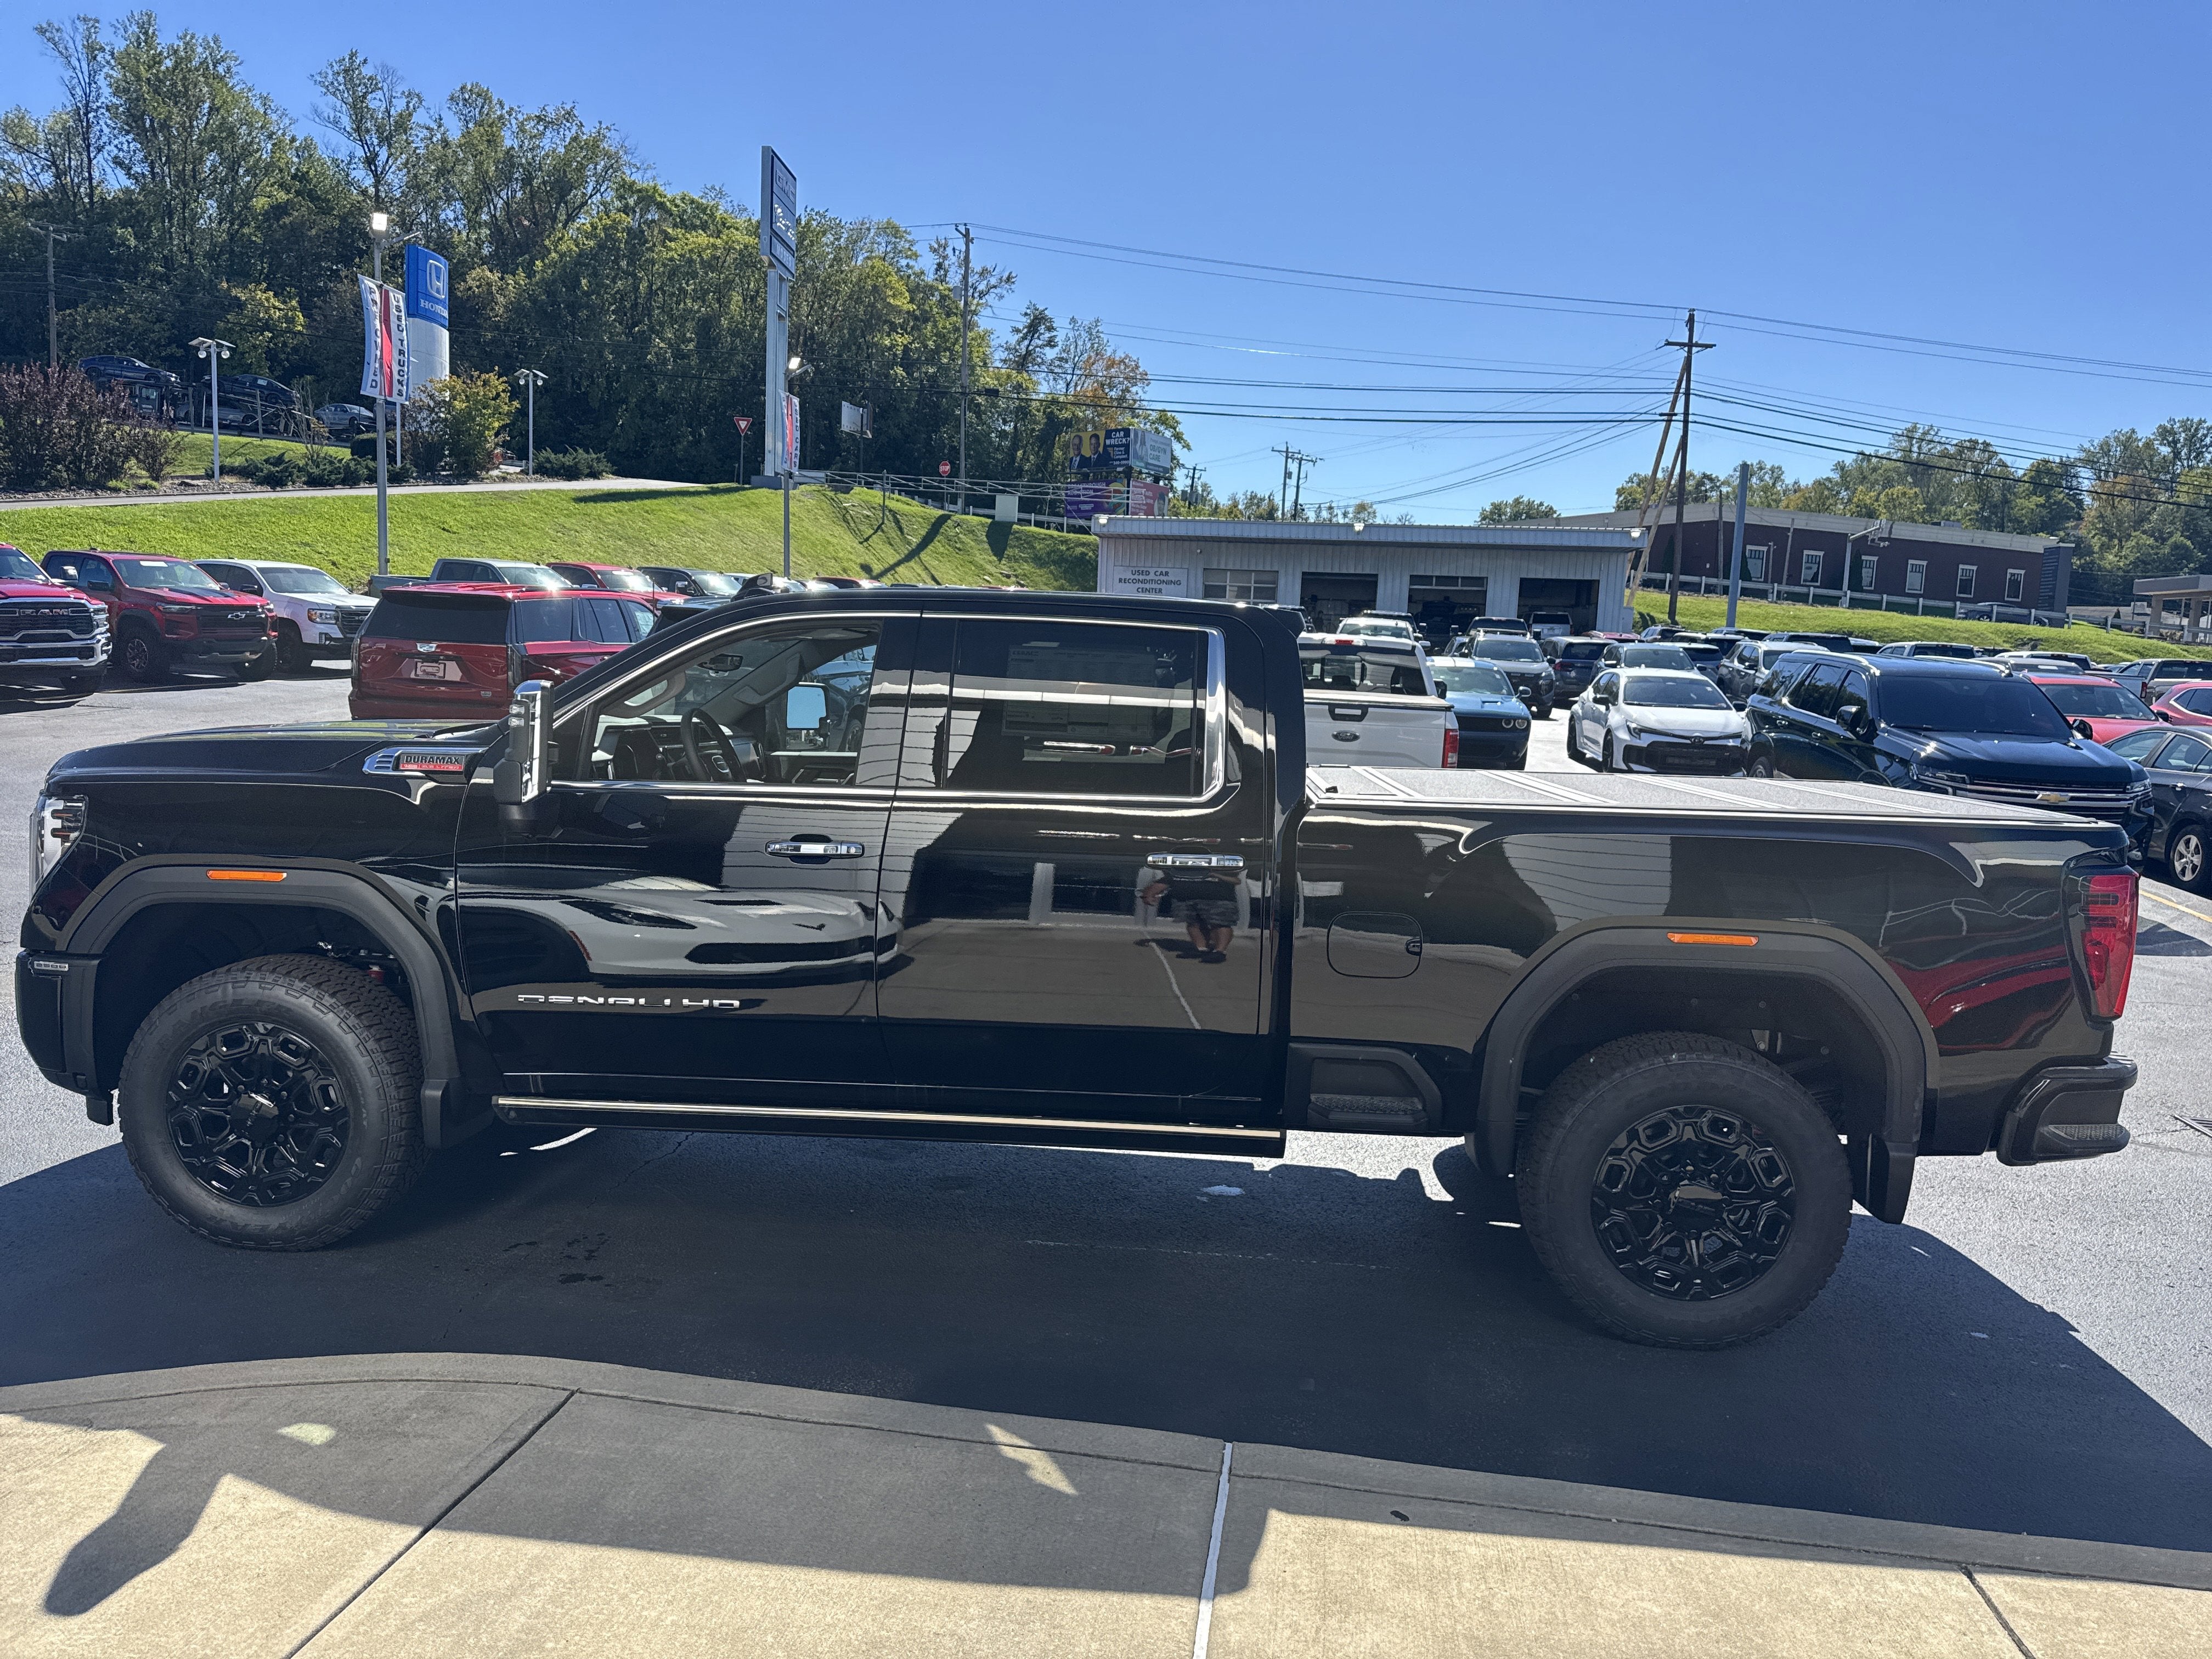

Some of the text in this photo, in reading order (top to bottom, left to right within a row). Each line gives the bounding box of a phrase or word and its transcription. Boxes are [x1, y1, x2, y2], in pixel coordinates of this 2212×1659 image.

[775, 169, 795, 204] GMC
[776, 245, 792, 267] MOSES
[394, 294, 406, 397] USED TRUCKS
[1150, 444, 1167, 455] OB/GYN
[1149, 453, 1161, 462] CARE
[404, 755, 460, 764] DURAMAX
[517, 995, 740, 1008] DENALI HD
